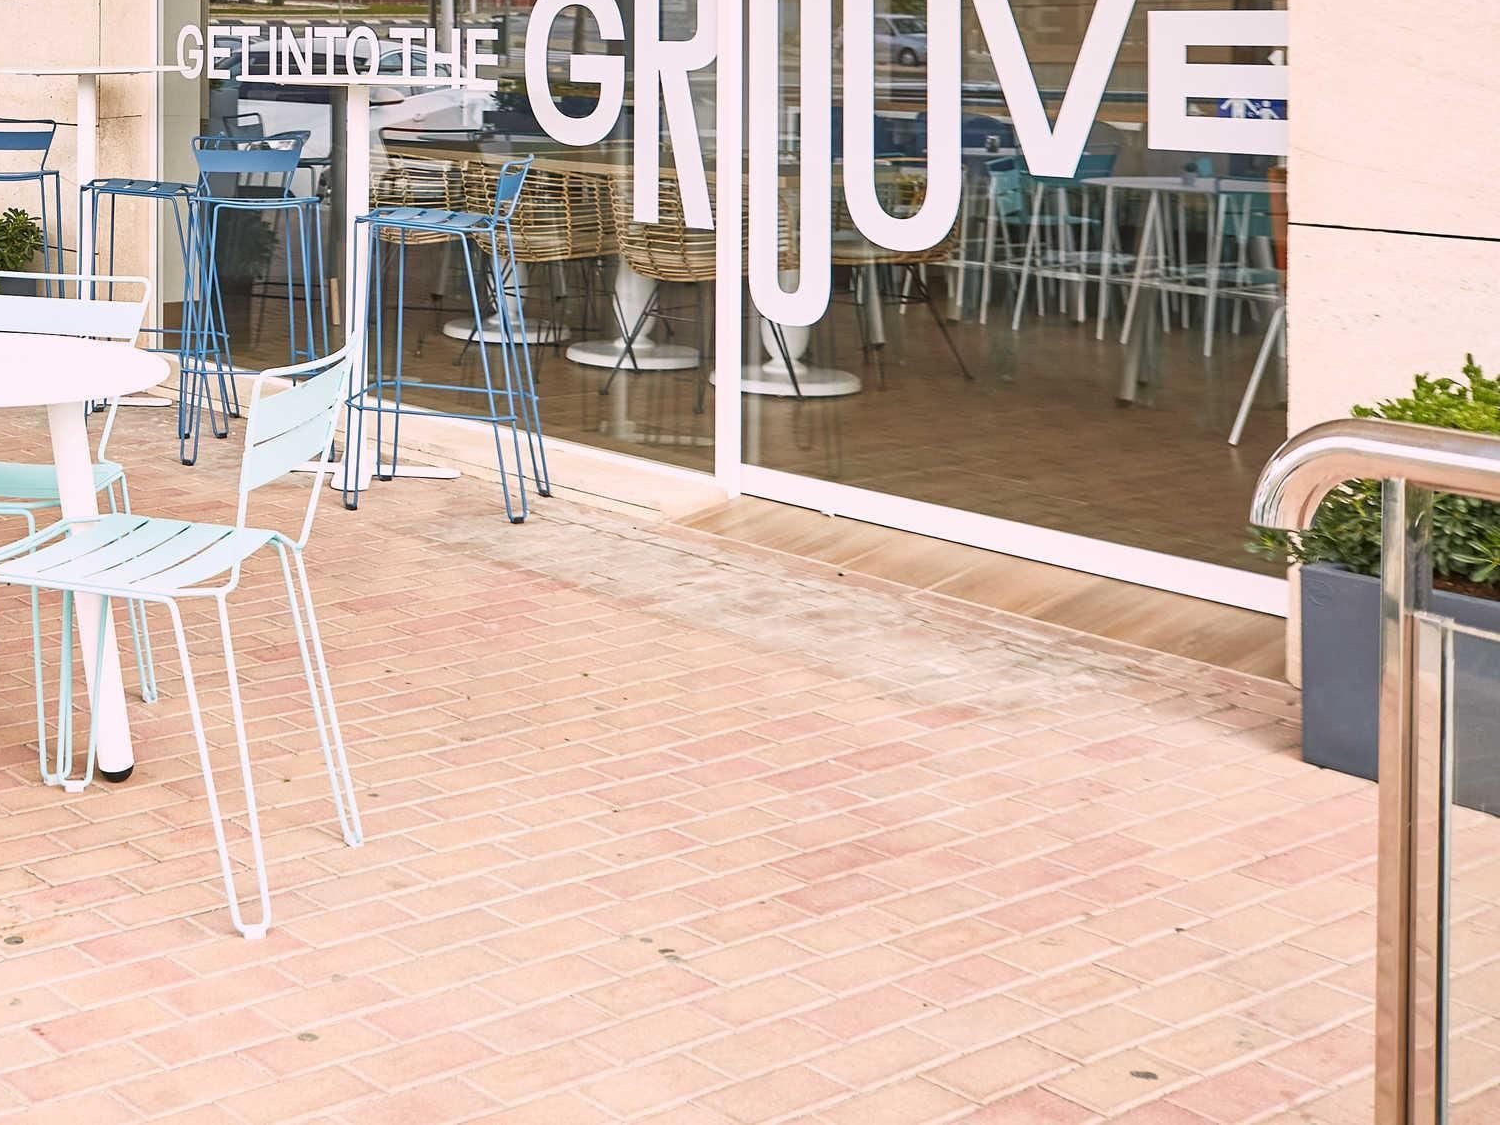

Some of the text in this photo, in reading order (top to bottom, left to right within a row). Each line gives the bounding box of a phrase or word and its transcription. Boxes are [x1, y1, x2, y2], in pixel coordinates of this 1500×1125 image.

[176, 24, 260, 79] GET
[269, 26, 380, 78] INTO
[389, 27, 499, 92] THE
